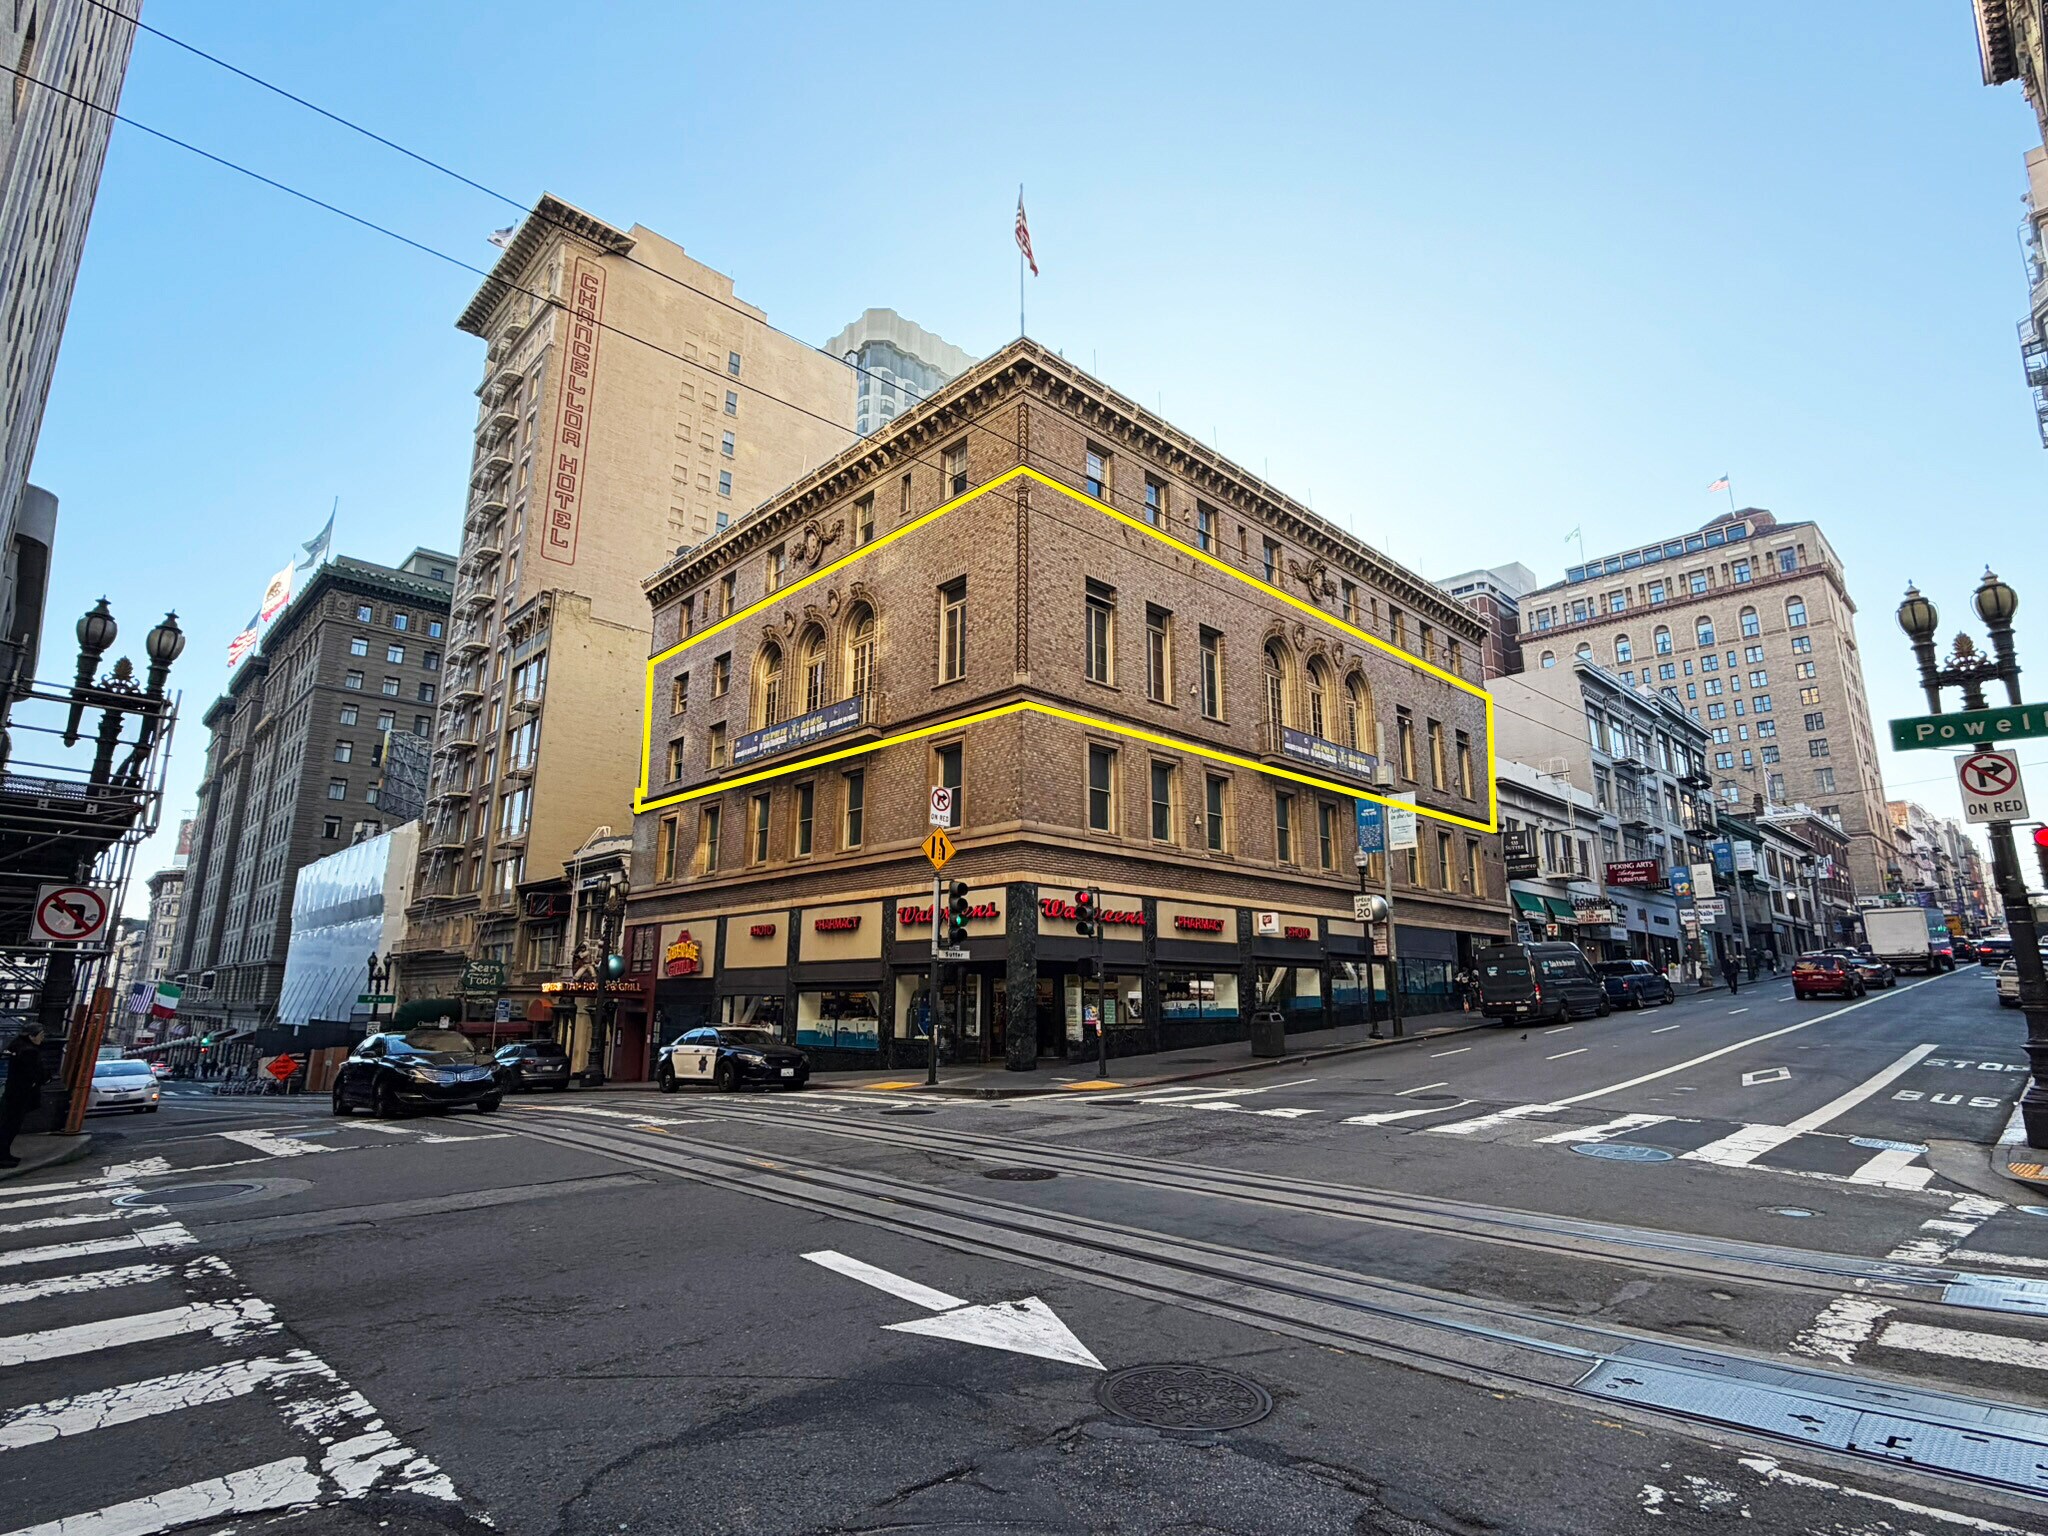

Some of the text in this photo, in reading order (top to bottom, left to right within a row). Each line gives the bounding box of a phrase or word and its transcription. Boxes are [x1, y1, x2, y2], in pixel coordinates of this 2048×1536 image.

[550, 272, 598, 548] CHANCELLOR HOTEL
[1968, 799, 2023, 816] ON RED
[1357, 908, 1371, 918] 20
[750, 924, 776, 936] PHOTO
[815, 916, 861, 931] PHARMACY
[1176, 915, 1225, 932] PHARMACY
[1286, 926, 1311, 939] PHOTO
[470, 962, 500, 973] Sears
[468, 973, 497, 985] Food
[618, 982, 642, 991] GRILL
[1923, 1058, 2031, 1072] STOP
[1891, 1089, 2002, 1108] BUS
